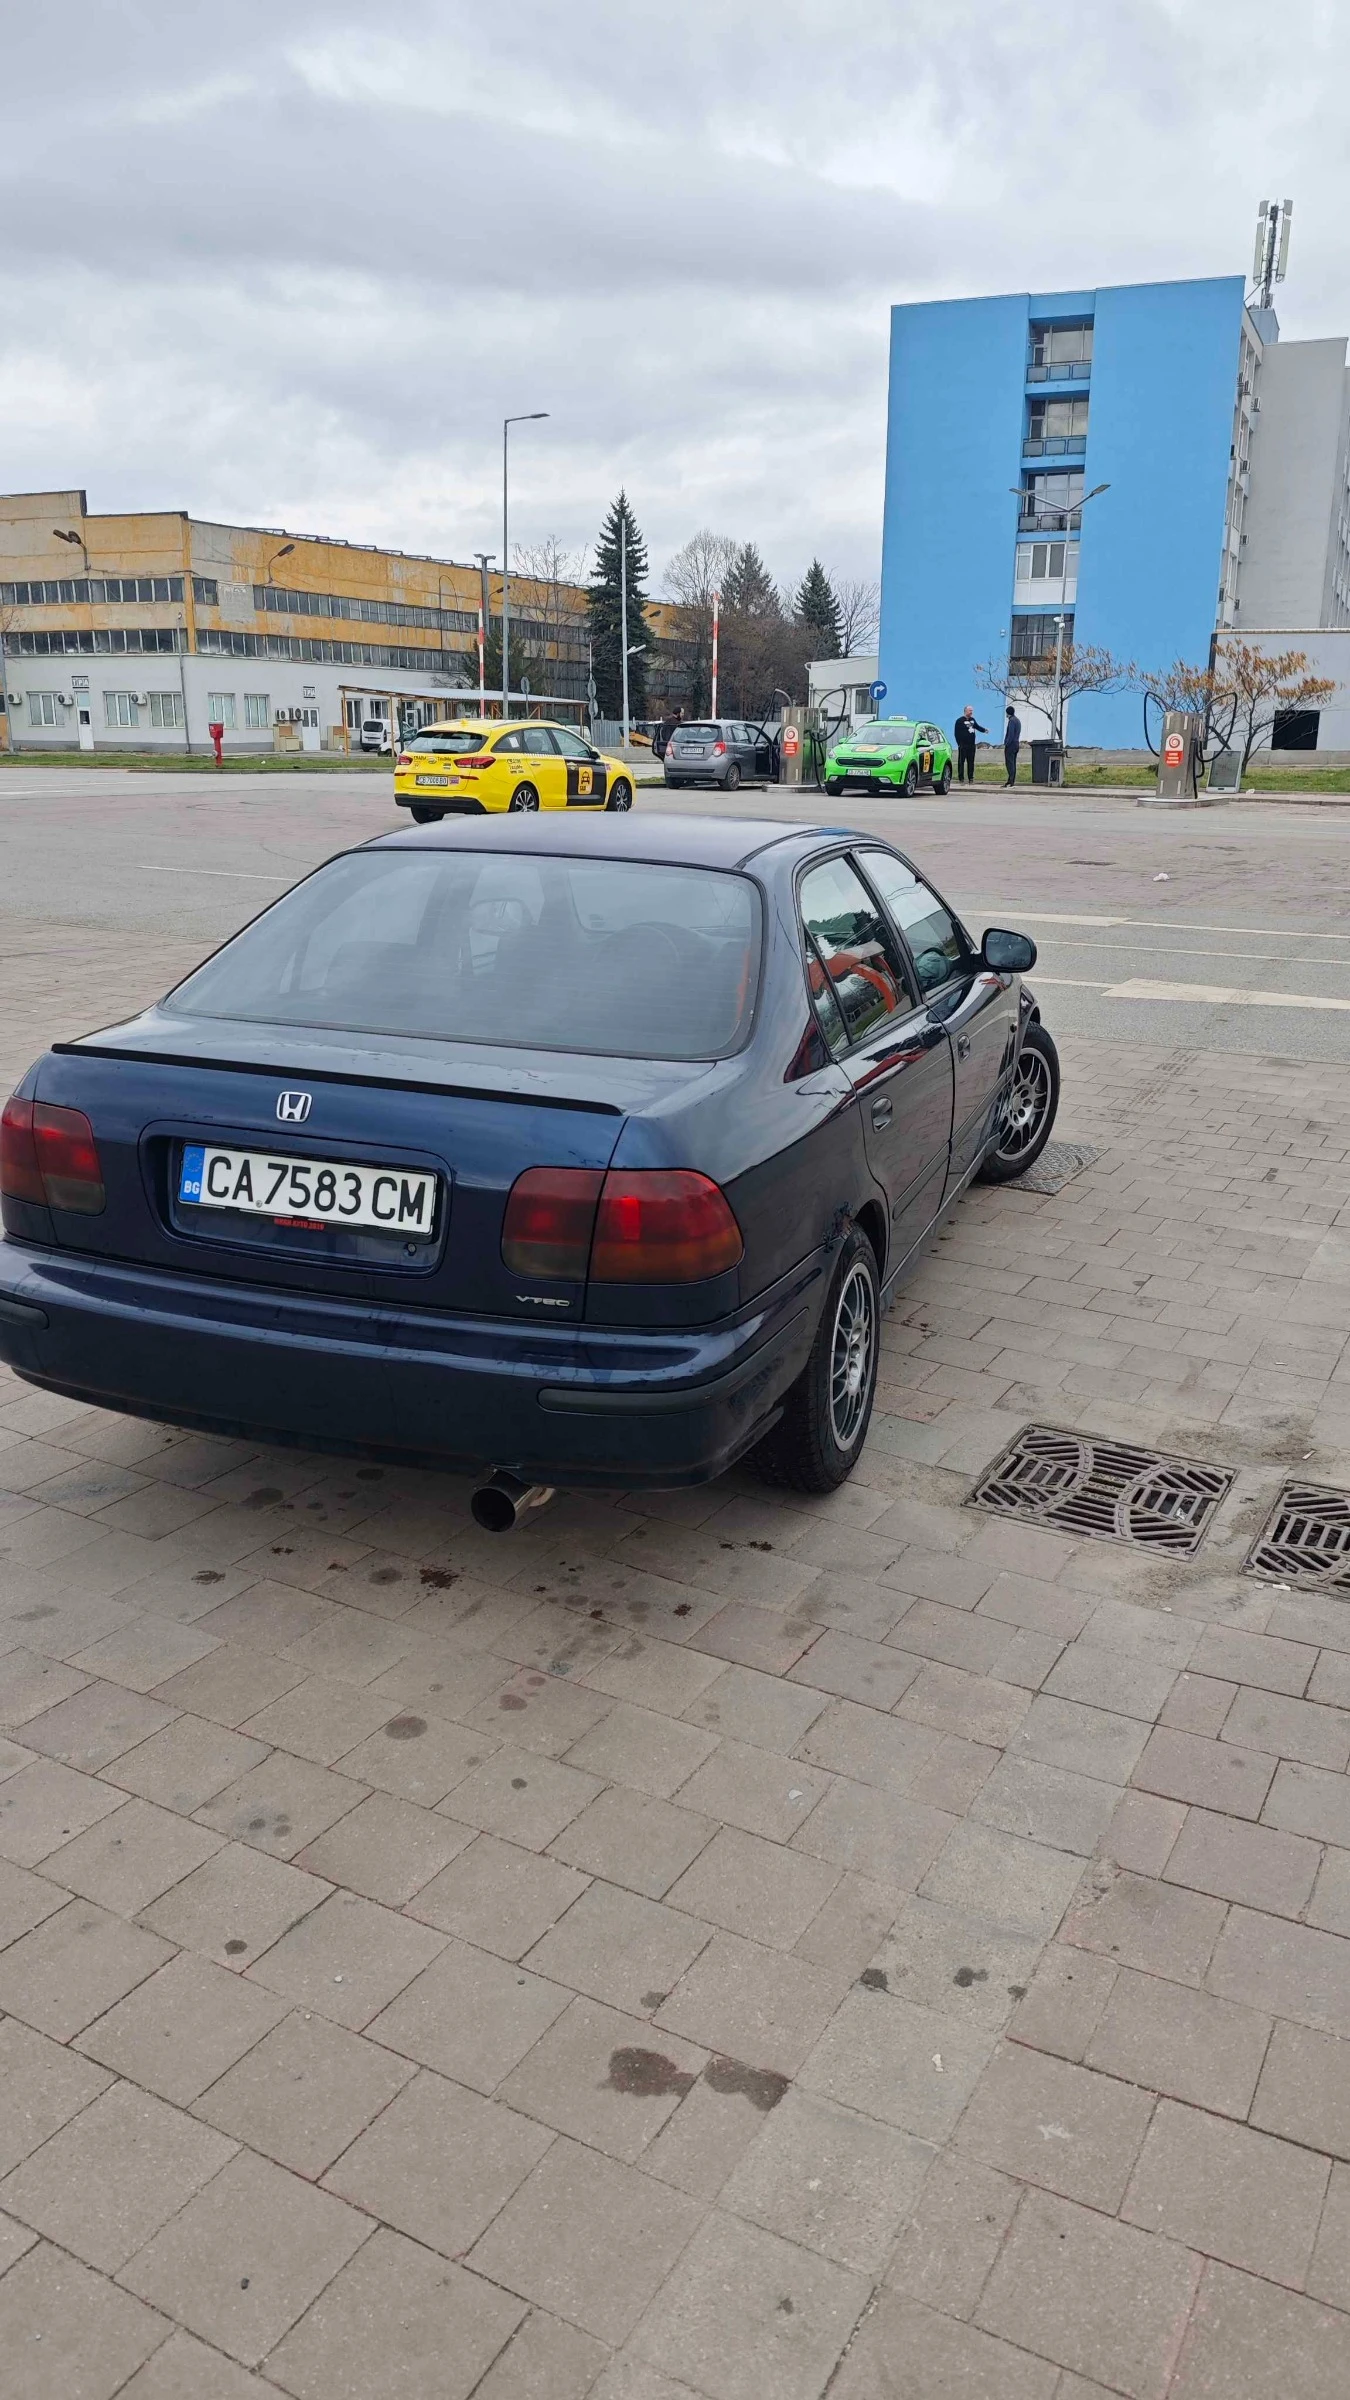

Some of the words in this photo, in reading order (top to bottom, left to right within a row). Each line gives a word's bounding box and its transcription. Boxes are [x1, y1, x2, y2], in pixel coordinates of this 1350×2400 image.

[183, 1180, 200, 1195] BG
[264, 1162, 362, 1215] 7583
[515, 1295, 570, 1307] VTEC
